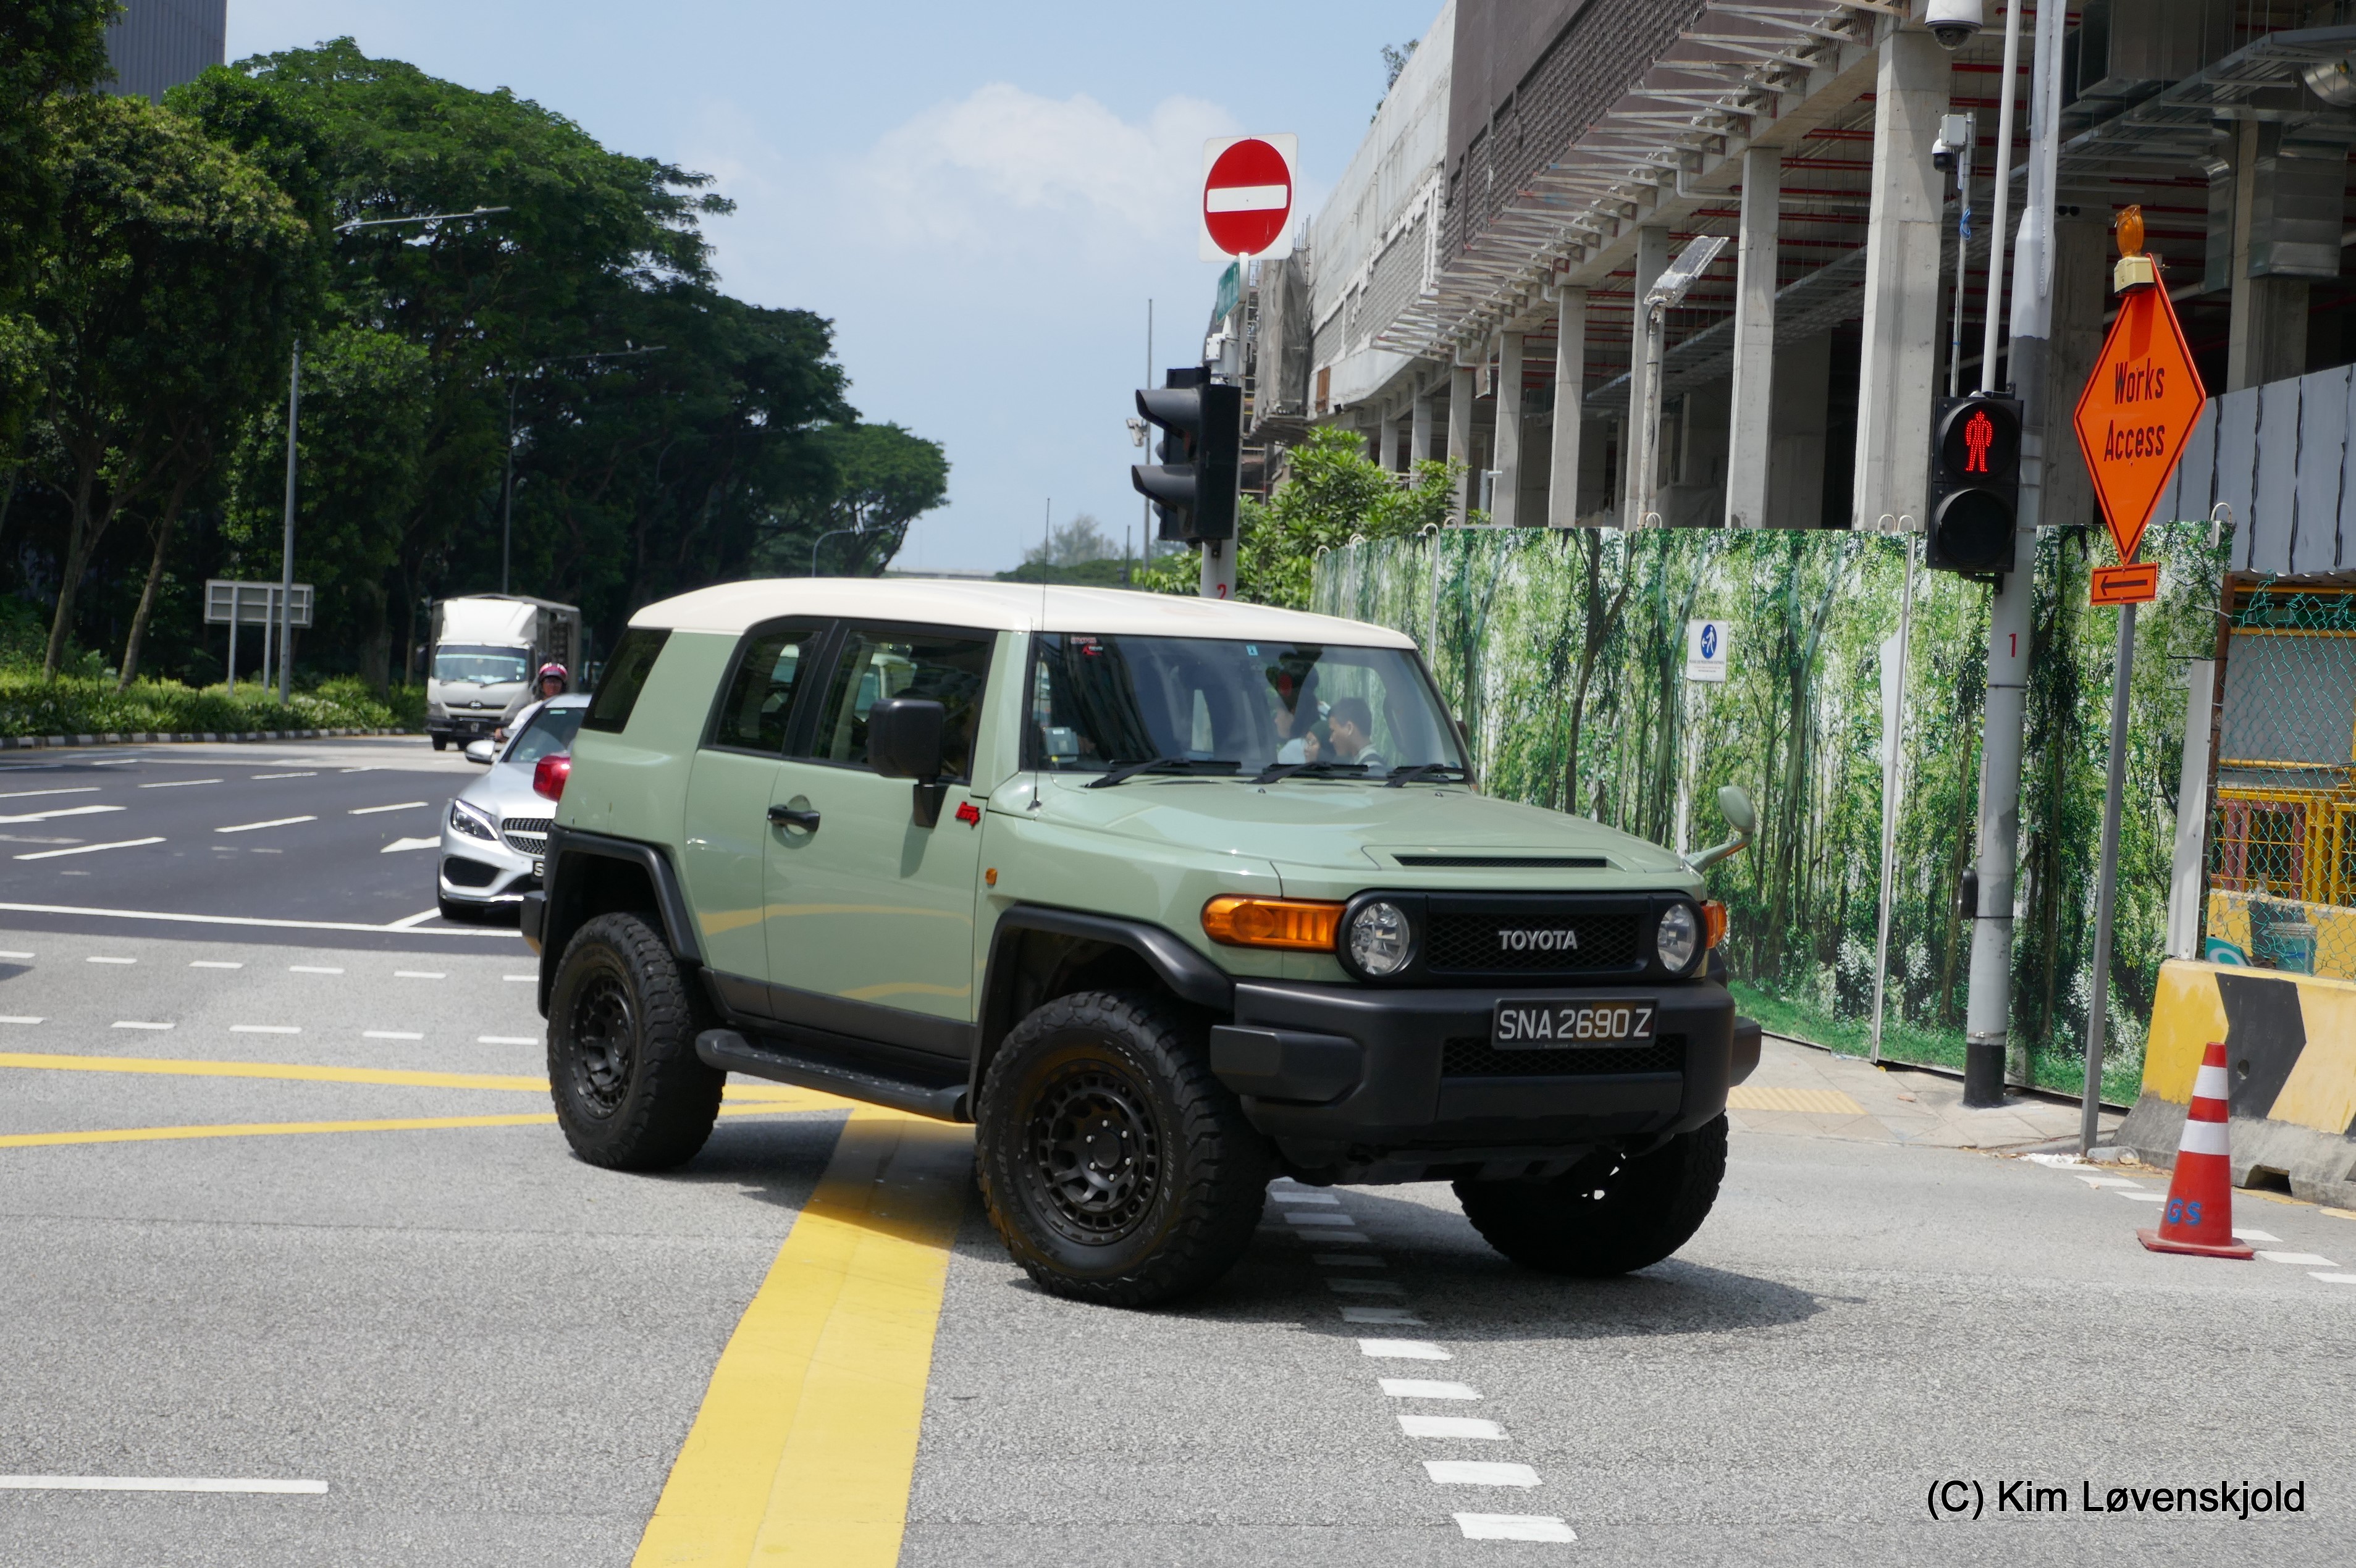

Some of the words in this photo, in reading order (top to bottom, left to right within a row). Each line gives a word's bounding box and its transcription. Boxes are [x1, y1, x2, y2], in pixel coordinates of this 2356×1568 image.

[2114, 357, 2165, 405] Works
[2103, 419, 2165, 461] Access
[2008, 633, 2016, 658] 1
[1499, 930, 1578, 950] TOYOTA
[2167, 1198, 2202, 1226] GS
